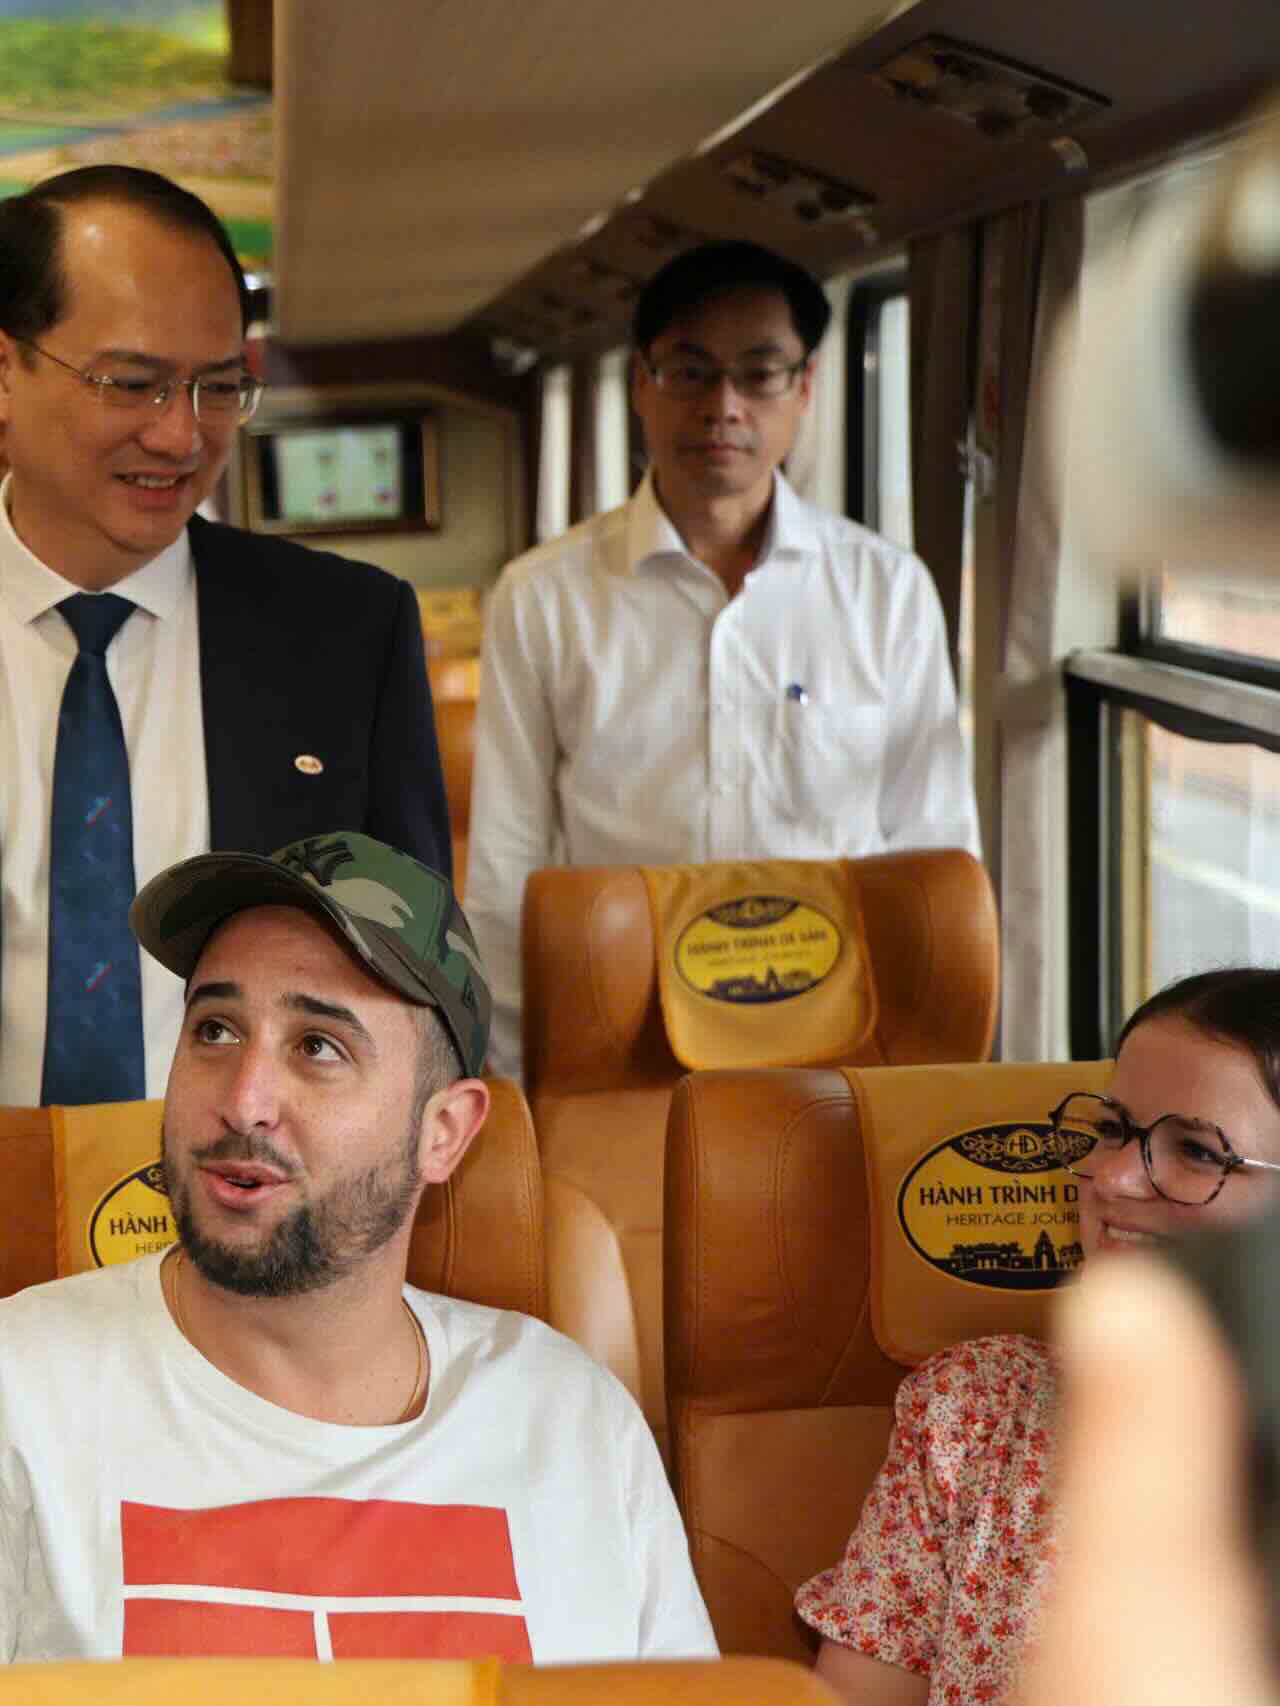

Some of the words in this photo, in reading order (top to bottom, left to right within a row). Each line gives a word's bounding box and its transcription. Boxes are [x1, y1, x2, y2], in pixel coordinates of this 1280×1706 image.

[920, 1181, 983, 1206] HÀNH
[989, 1178, 1057, 1204] TRÌNH
[1064, 1184, 1079, 1202] D
[109, 1211, 168, 1235] HÀNH
[946, 1212, 1025, 1225] HERITAGE
